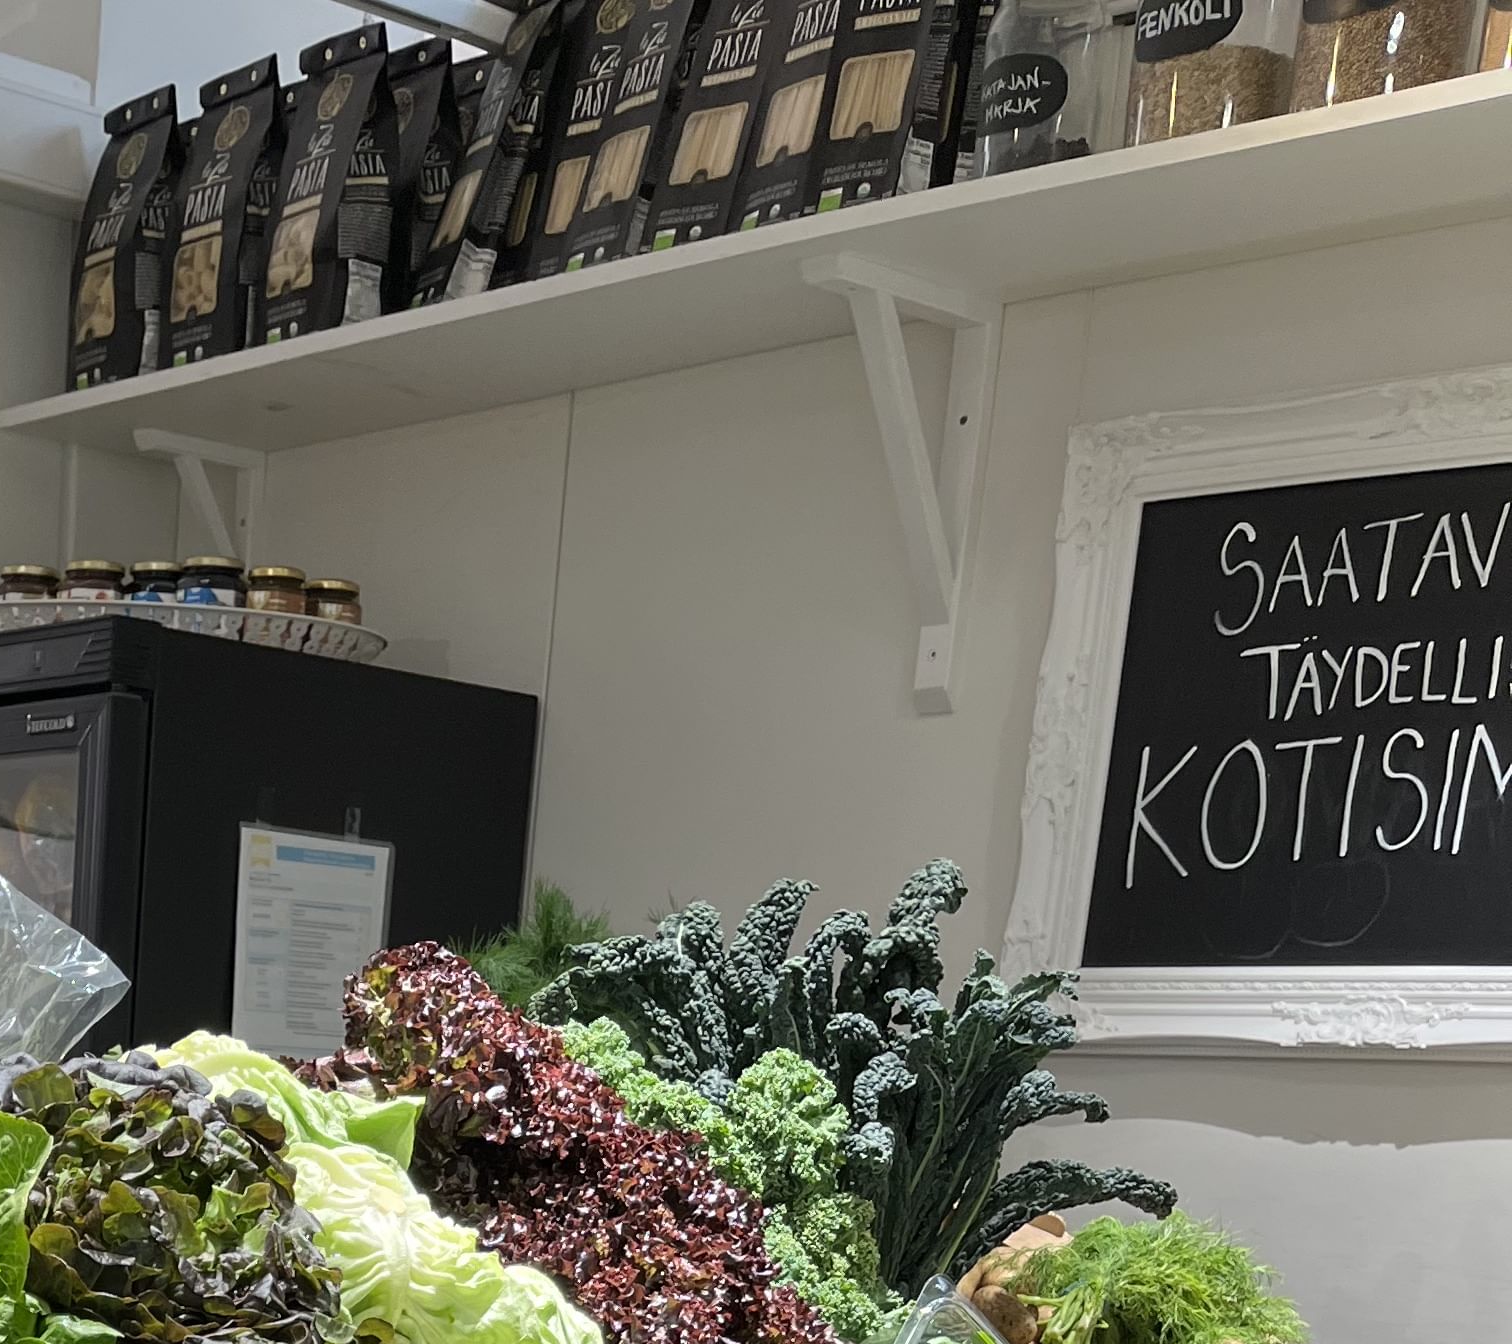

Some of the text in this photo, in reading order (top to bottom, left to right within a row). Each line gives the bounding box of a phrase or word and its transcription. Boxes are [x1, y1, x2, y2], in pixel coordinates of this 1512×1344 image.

[791, 0, 839, 46] PASTA
[707, 29, 763, 72] PASTA
[619, 54, 665, 99] PASTA
[571, 80, 613, 121] PAST
[287, 156, 330, 200] PASTA
[350, 154, 386, 176] ASTA
[184, 184, 226, 226] PASTA
[87, 214, 126, 251] PASTA
[1239, 634, 1512, 722] TÄYDELLI
